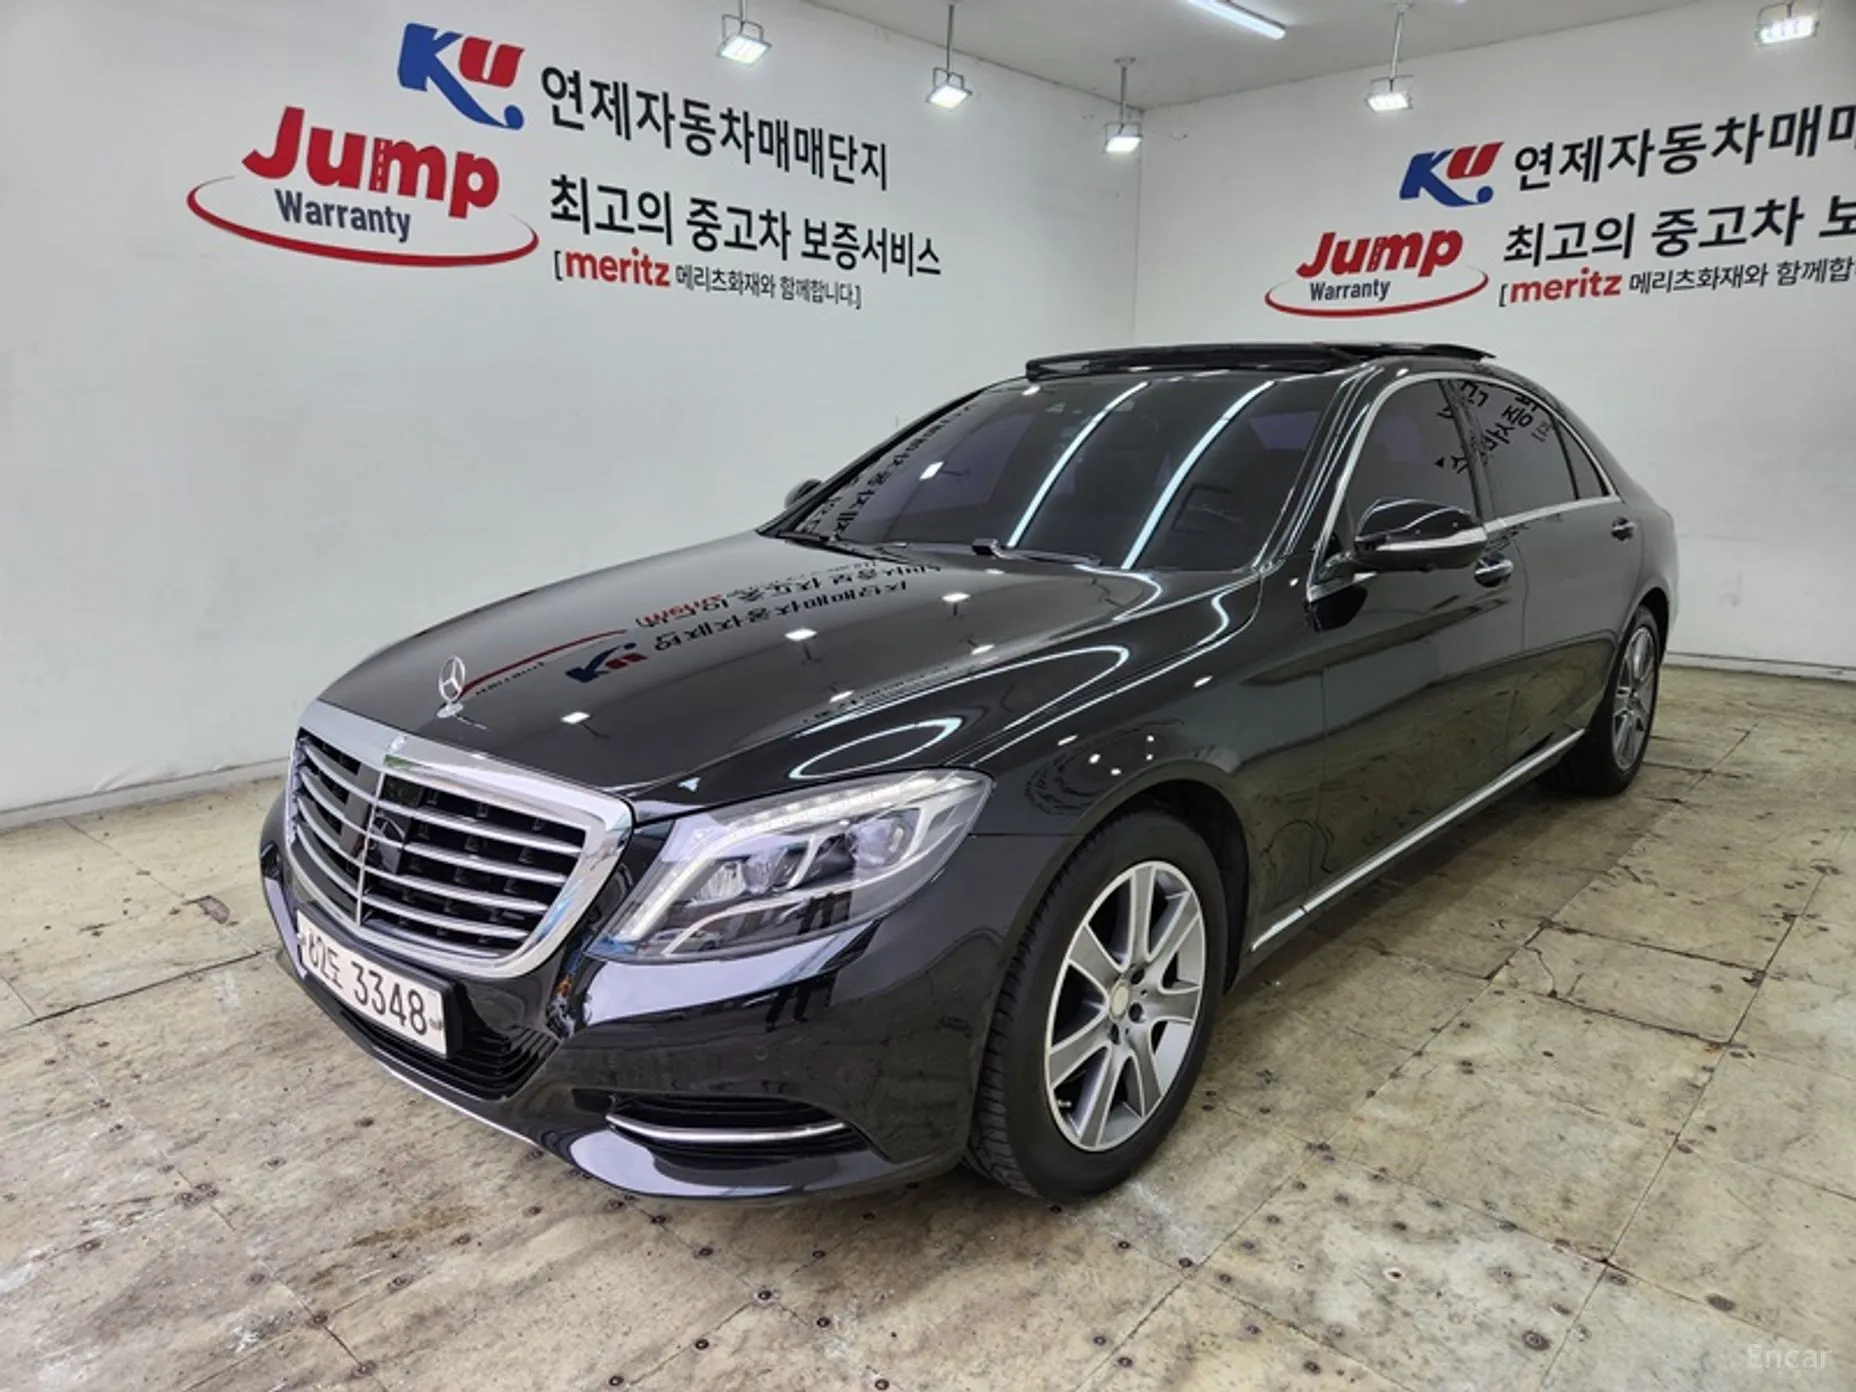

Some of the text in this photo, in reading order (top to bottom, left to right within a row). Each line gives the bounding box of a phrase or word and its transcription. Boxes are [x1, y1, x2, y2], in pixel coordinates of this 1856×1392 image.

[540, 66, 889, 191] 연제자동차매매단지
[241, 105, 499, 219] Jump
[275, 188, 411, 243] Warranty
[550, 174, 942, 277] 최고의 중고차 보증서비스
[1503, 212, 1636, 267] 최고의
[1651, 196, 1805, 256] 중고차
[675, 264, 776, 299] 메리츠화재와
[1296, 229, 1463, 278] Jump
[1629, 262, 1769, 295] 메리츠화재와
[1309, 280, 1391, 302] Warranty
[351, 960, 428, 1036] 3348
